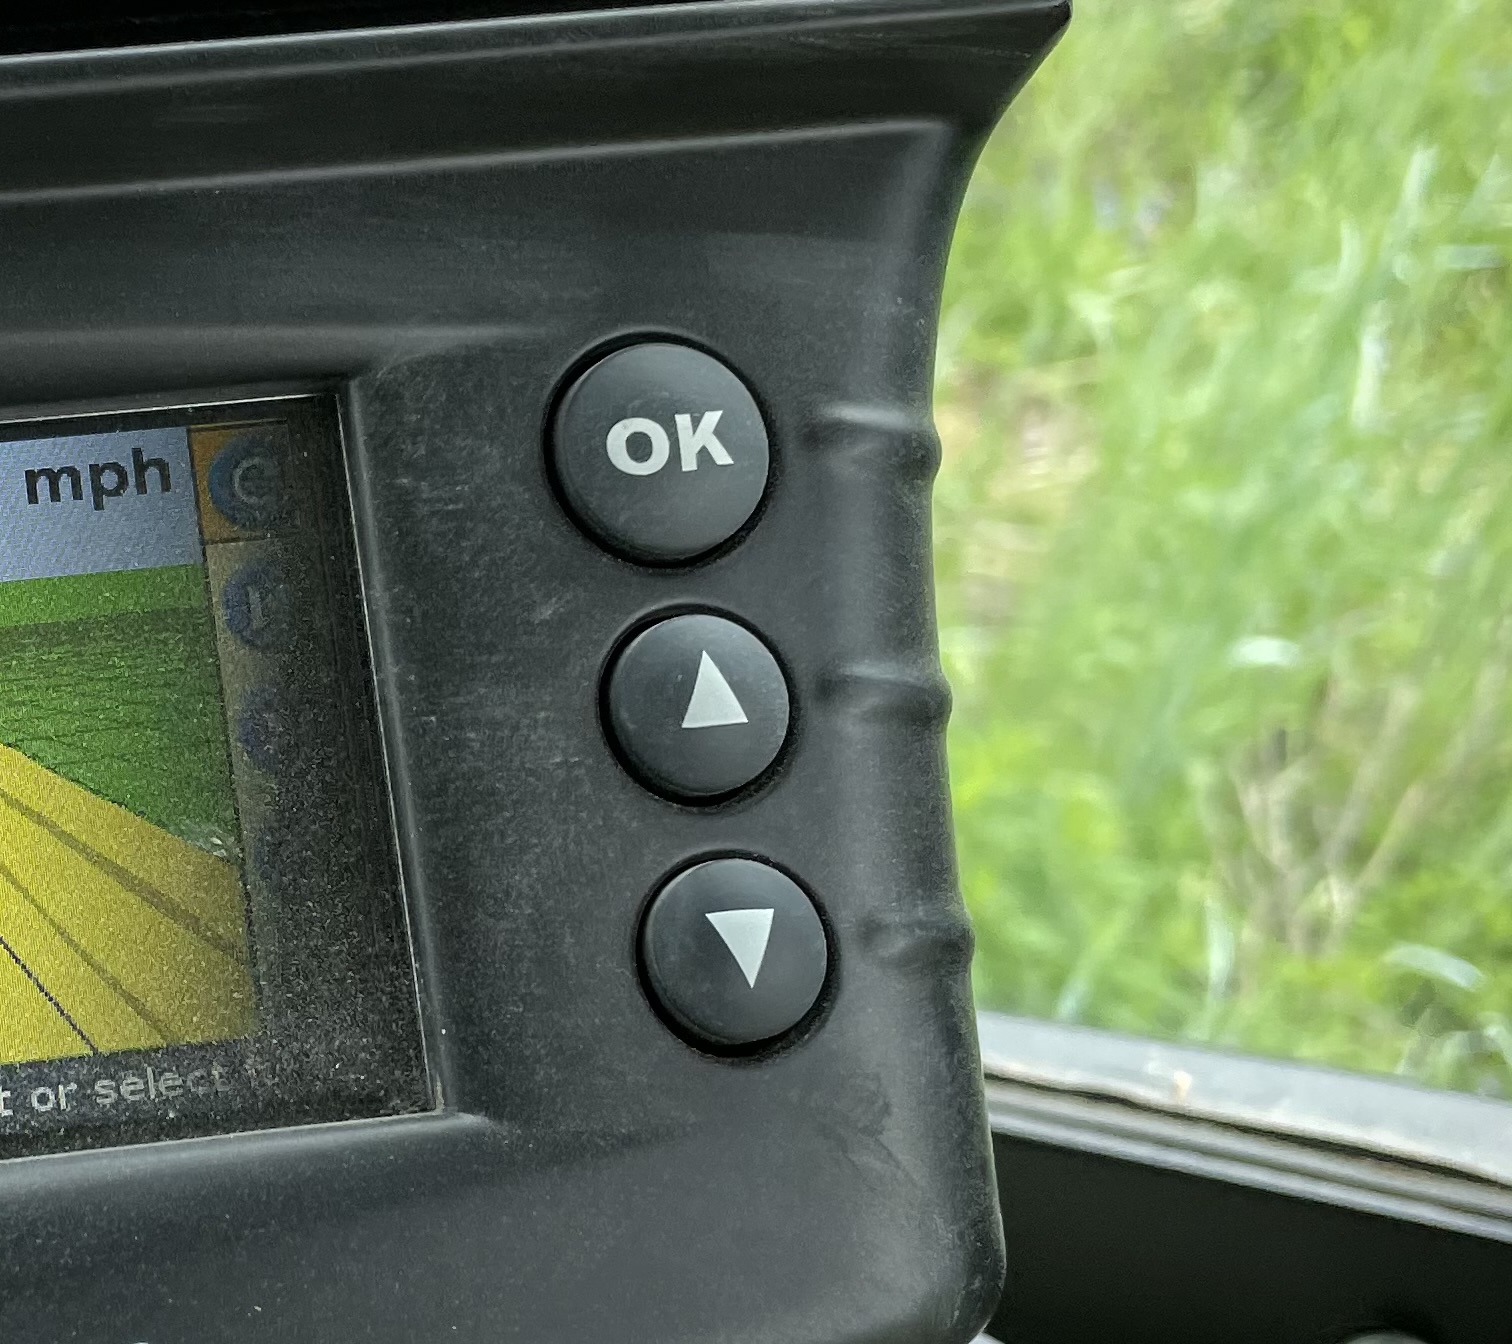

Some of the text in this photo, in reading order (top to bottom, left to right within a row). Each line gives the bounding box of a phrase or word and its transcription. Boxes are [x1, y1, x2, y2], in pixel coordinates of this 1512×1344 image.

[606, 410, 734, 476] OK
[24, 446, 172, 512] mph
[30, 1080, 78, 1113] or
